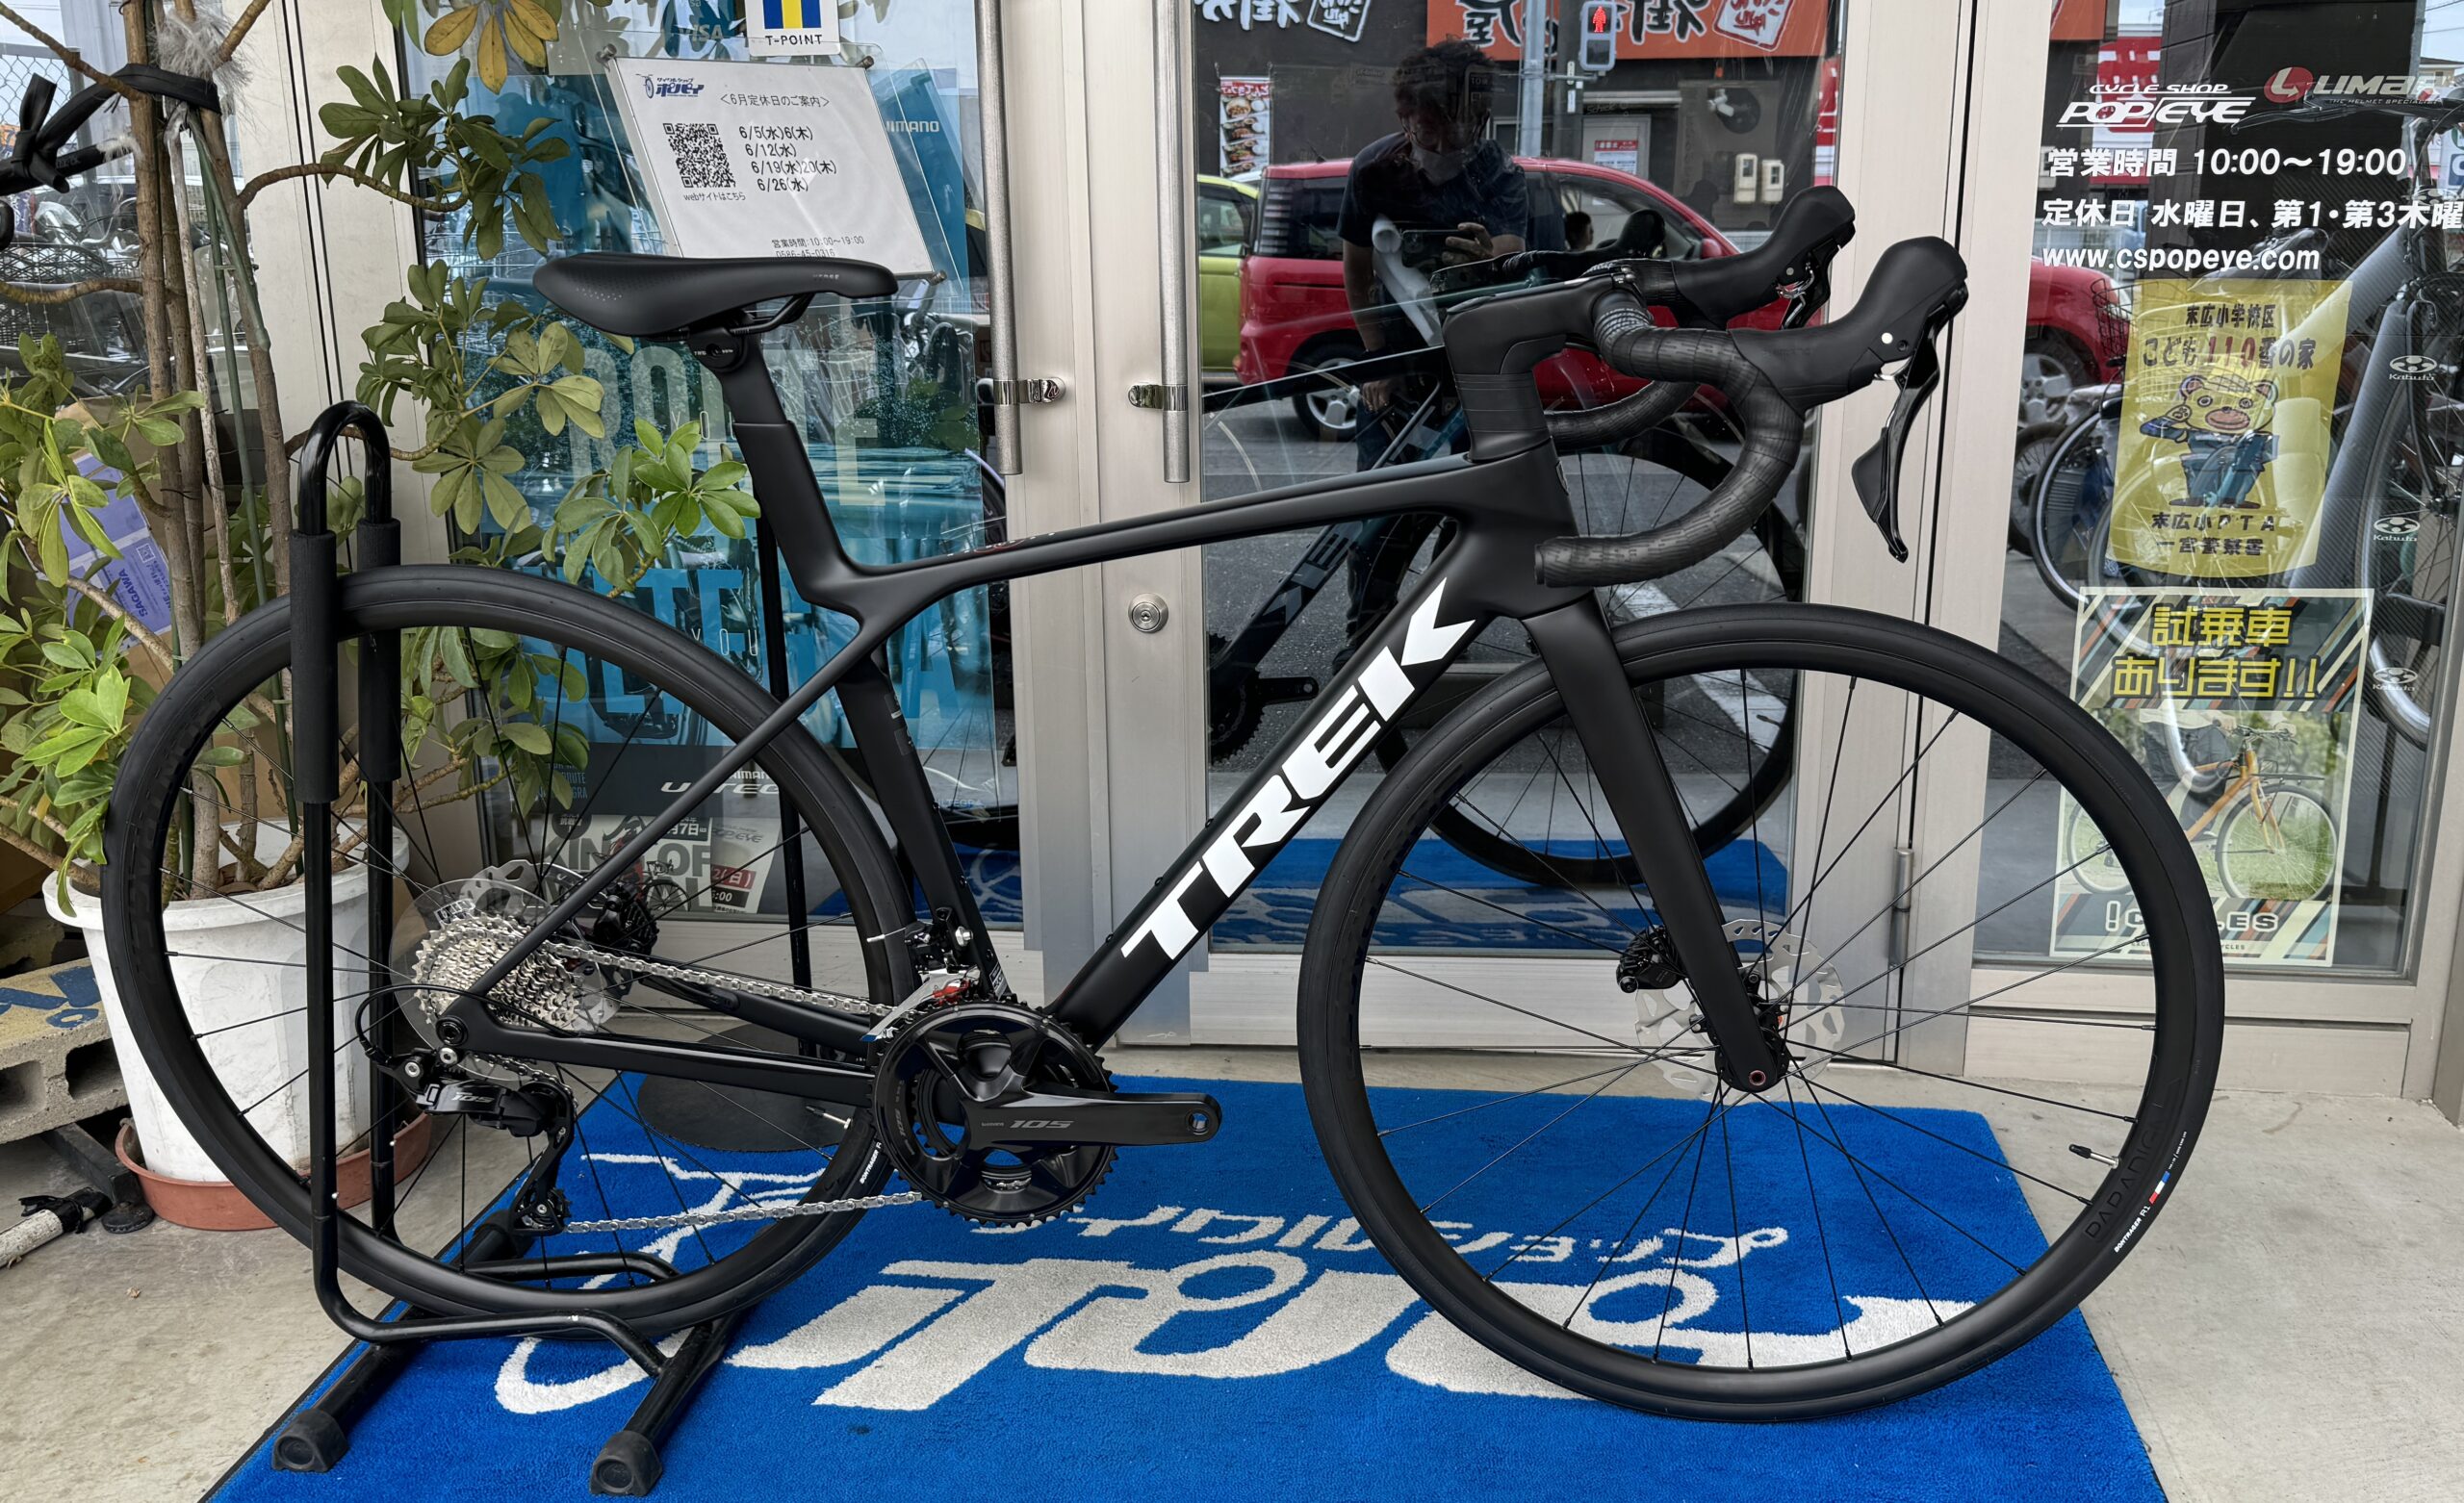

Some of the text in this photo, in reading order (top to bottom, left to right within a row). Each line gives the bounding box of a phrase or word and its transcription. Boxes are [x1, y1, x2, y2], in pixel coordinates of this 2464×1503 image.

[764, 34, 823, 46] T-POINT
[2089, 84, 2229, 93] CYCLE SHOP
[738, 126, 813, 140] 6/5(水)6(木)
[886, 120, 940, 133] IMANO
[745, 143, 797, 157] 6/12(水)
[2047, 147, 2178, 177] 営業時間
[751, 160, 836, 174] 6/19(水)20(木)
[683, 191, 746, 202] webサイトはこちら
[757, 177, 808, 191] 6/26(水)
[2041, 198, 2136, 227] 定休日
[2041, 246, 2321, 271] www.cspopeye.com
[2185, 303, 2276, 329] 末広小学校区
[2143, 335, 2317, 370] こども110番の家
[117, 568, 151, 620] SAGAWA
[2151, 606, 2293, 648] 試乗車
[2113, 656, 2321, 699] あります!!
[1120, 576, 1476, 960] TREK
[1010, 1120, 1075, 1129] 105
[859, 1149, 880, 1185] BONTRAGER
[2114, 1216, 2143, 1254] BONTRAGER
